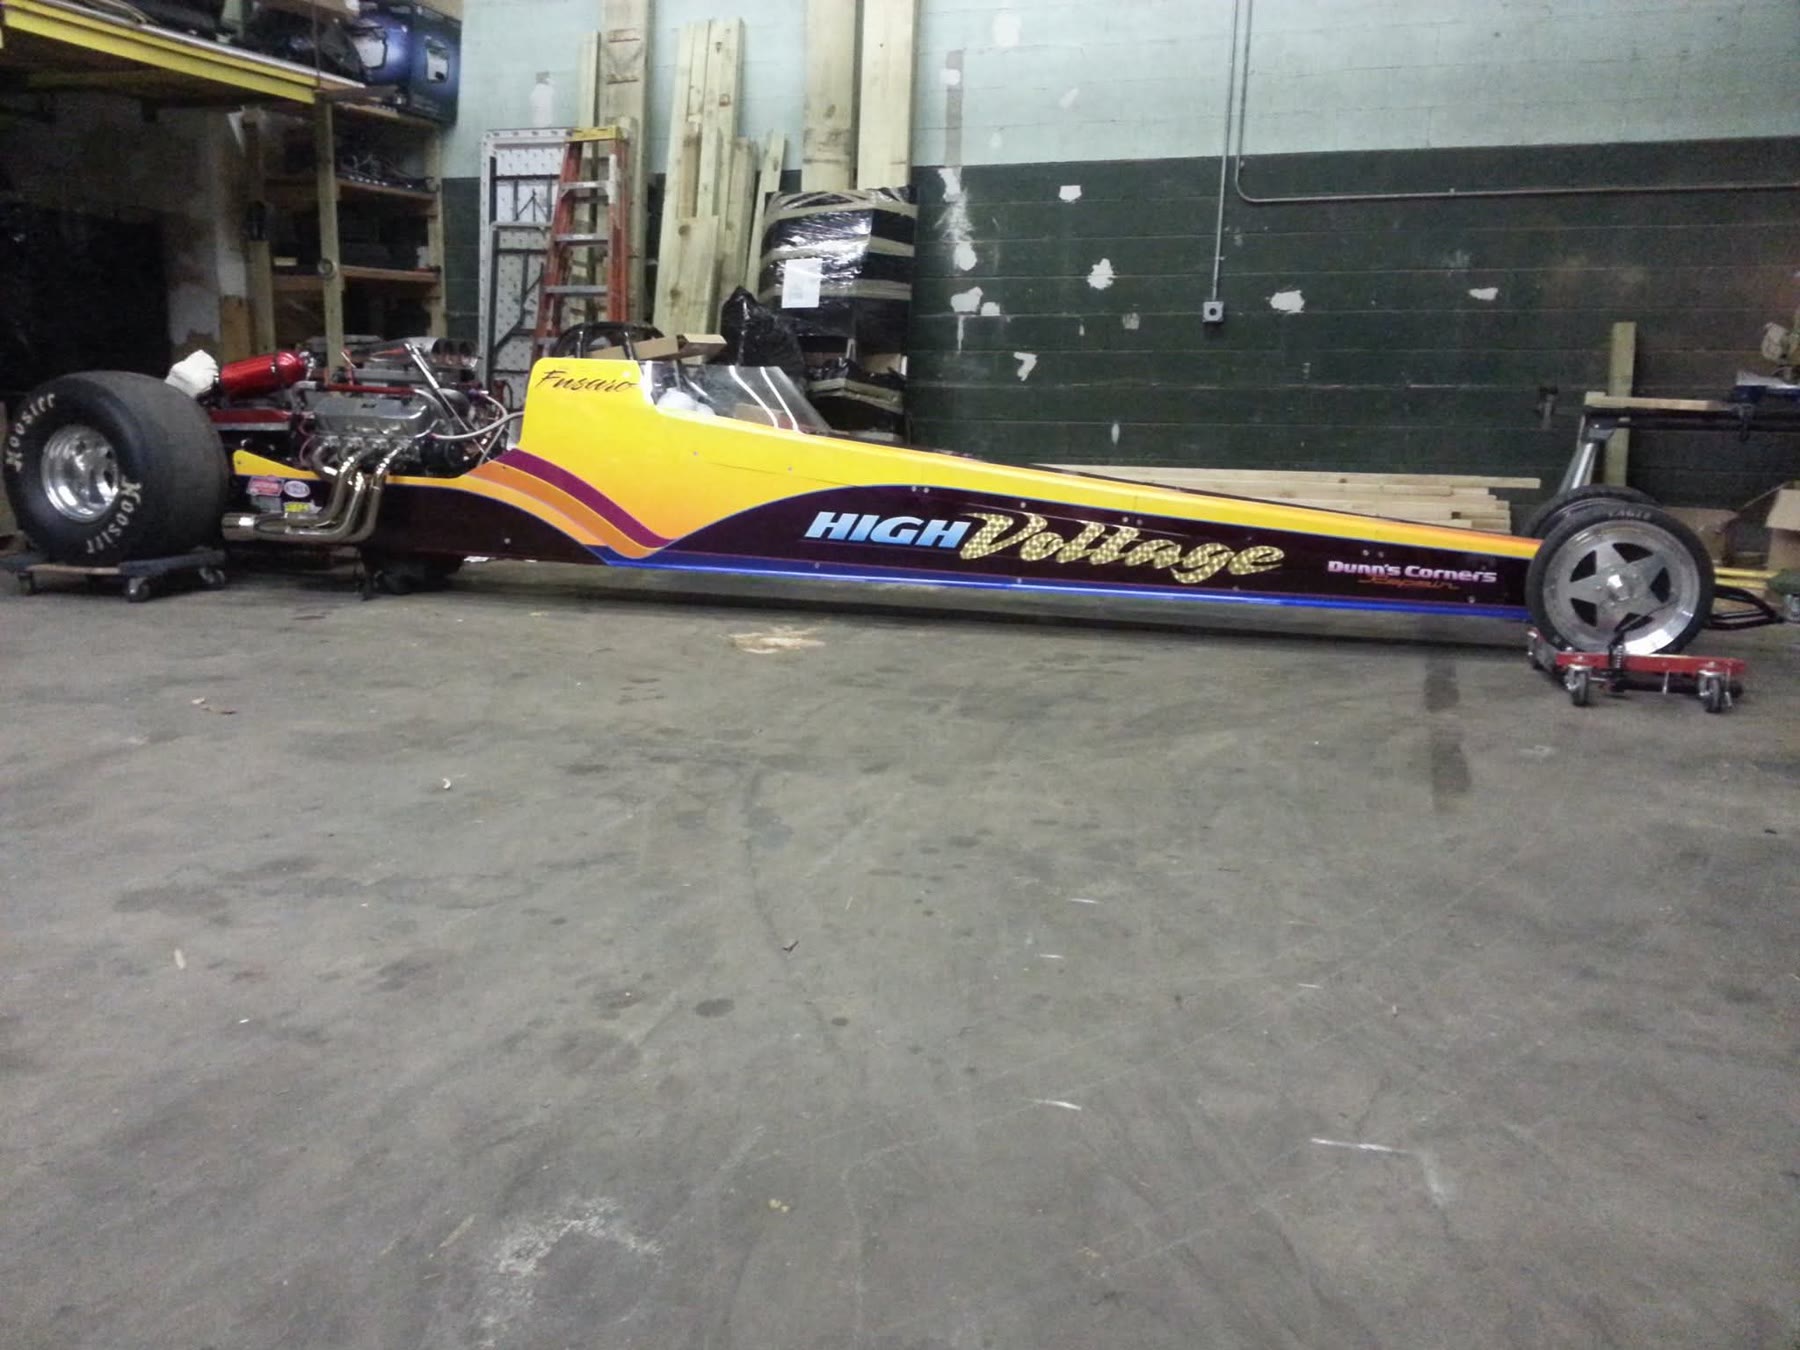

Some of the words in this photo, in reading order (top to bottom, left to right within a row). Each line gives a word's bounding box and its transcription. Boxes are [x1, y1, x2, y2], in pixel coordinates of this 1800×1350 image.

[803, 511, 972, 549] HIGH
[959, 512, 1285, 584] Voltage
[1327, 560, 1401, 577] Dunn's
[1404, 564, 1498, 583] Corners
